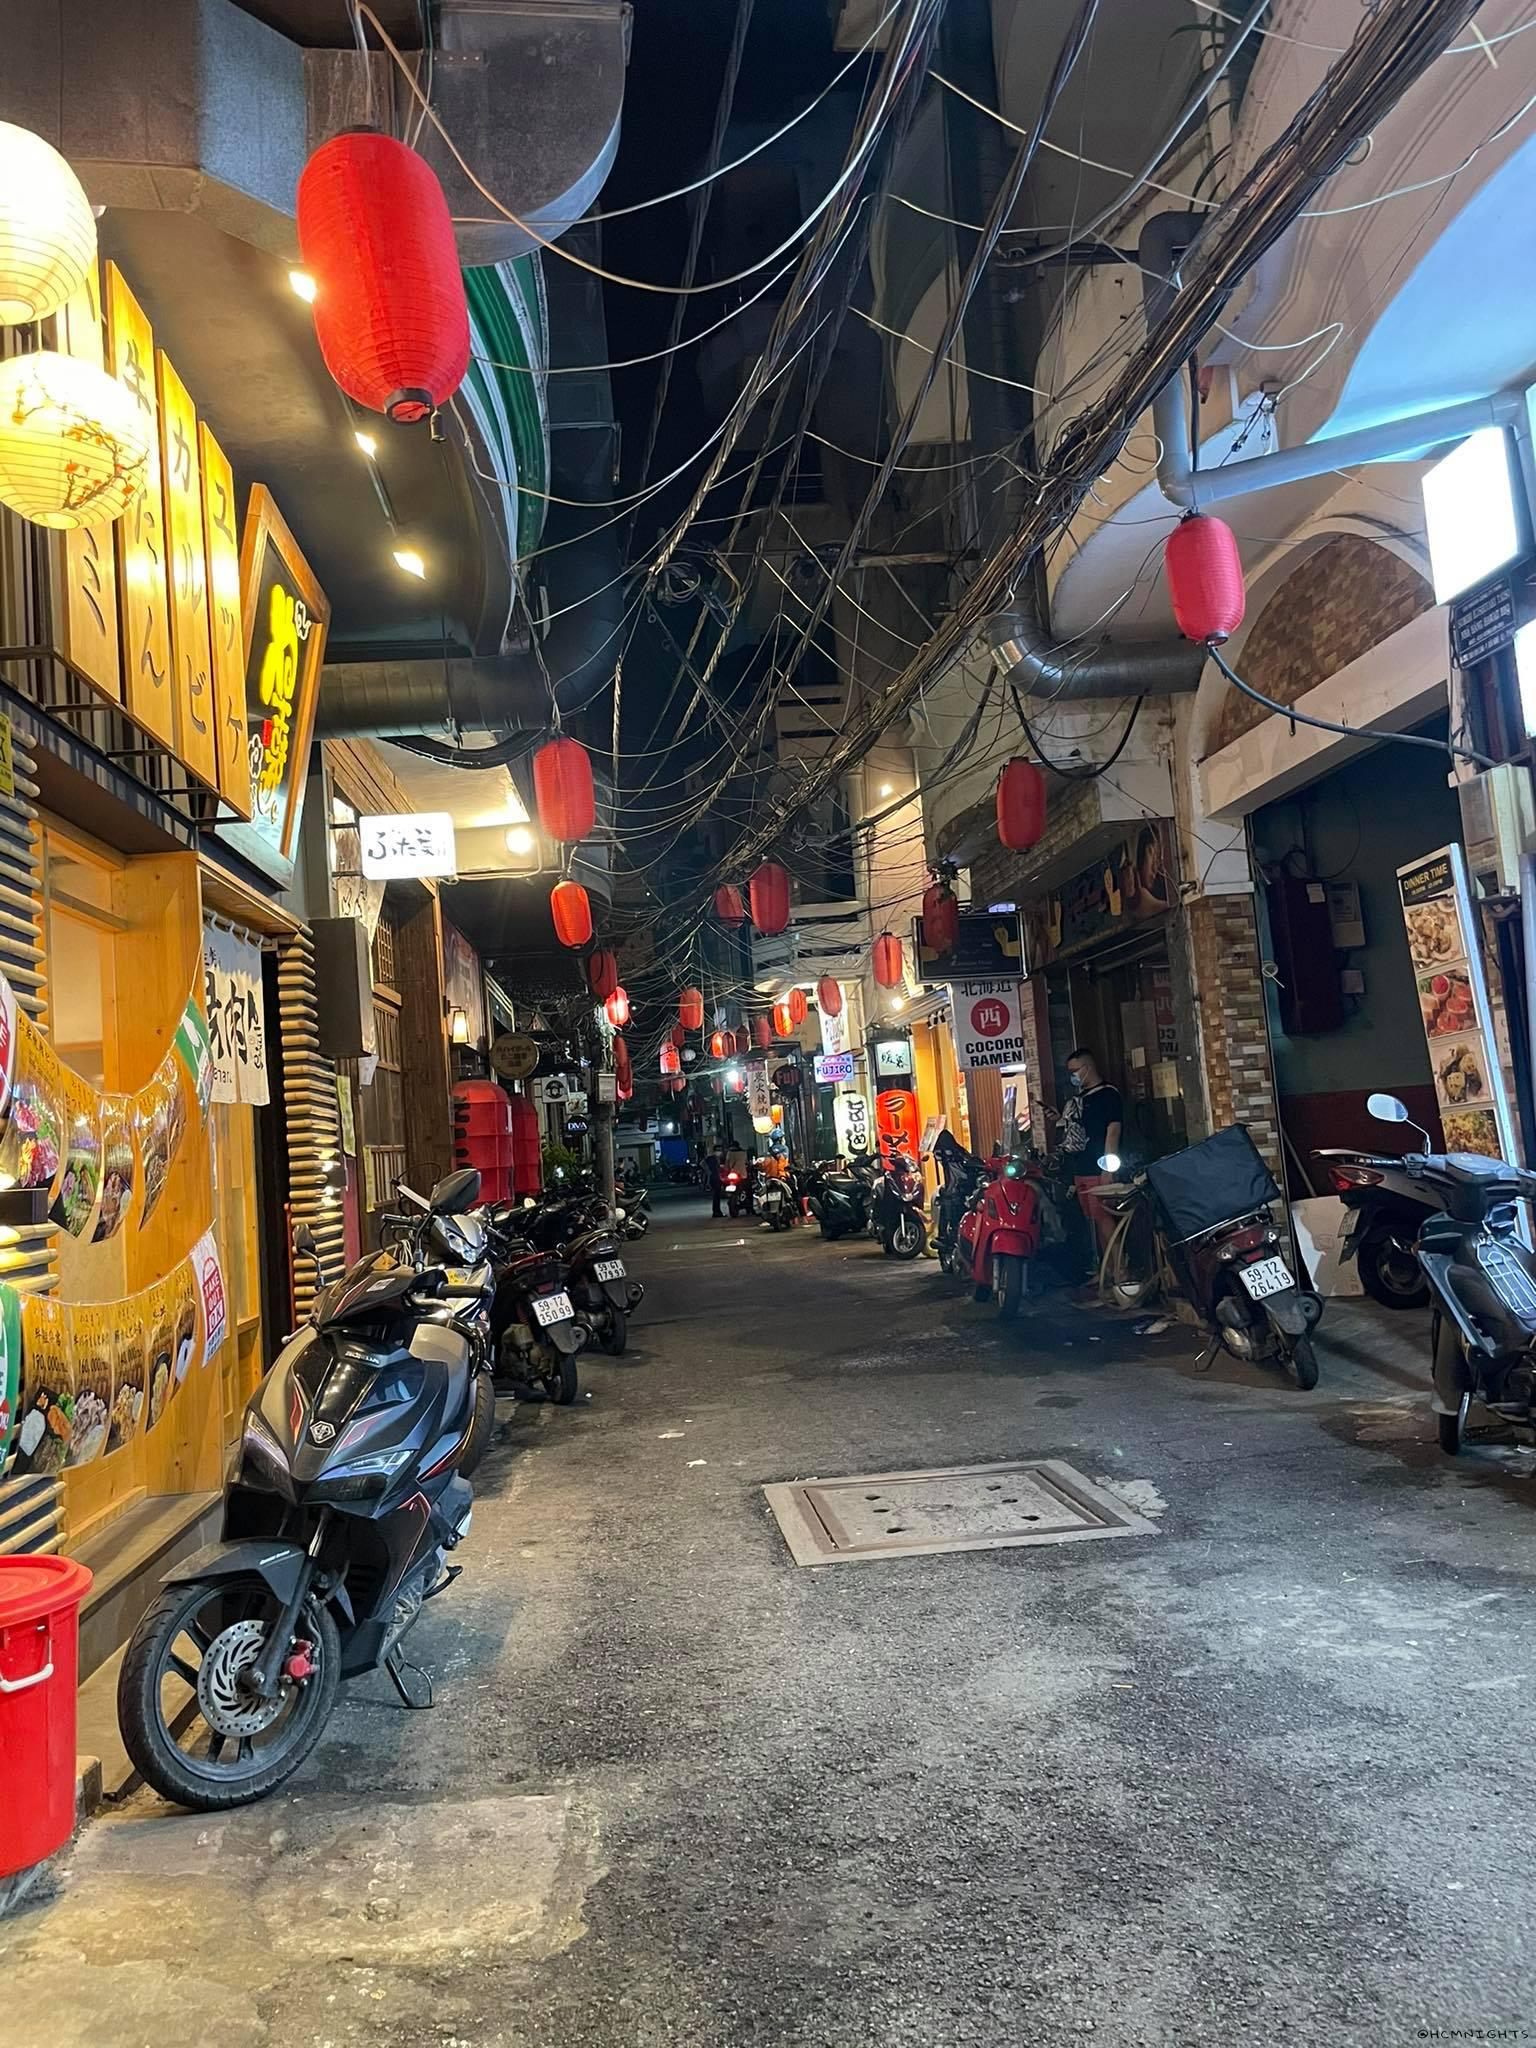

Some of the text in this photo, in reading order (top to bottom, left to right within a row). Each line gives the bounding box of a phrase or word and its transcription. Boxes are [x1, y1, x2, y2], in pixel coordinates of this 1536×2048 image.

[173, 417, 207, 735] カルビ
[1403, 871, 1430, 890] DINNER
[1430, 863, 1448, 879] TIME
[965, 1037, 1024, 1055] COCORO
[970, 1051, 1023, 1067] RAMEN
[816, 1064, 852, 1075] FUJIRO
[204, 1271, 220, 1298] TAKE
[208, 1286, 222, 1311] OUT
[209, 1300, 222, 1329] OK
